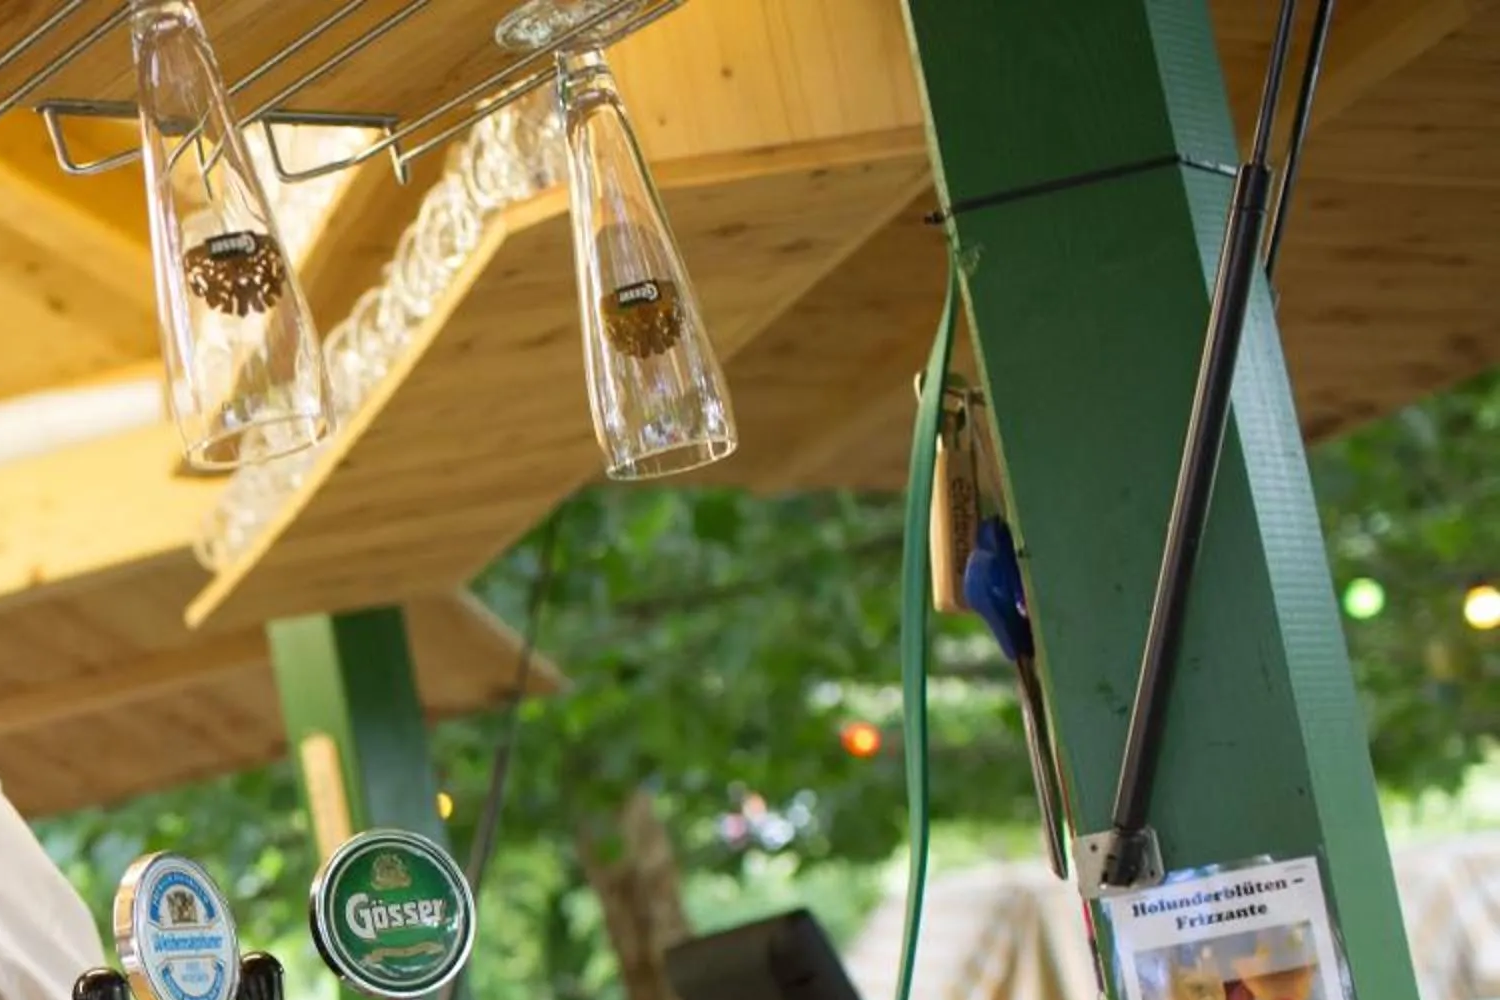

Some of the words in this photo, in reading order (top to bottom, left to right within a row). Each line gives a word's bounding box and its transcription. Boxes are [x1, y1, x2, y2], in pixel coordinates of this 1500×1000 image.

[345, 892, 446, 940] Gösser
[1132, 877, 1288, 917] Holunderblüten
[1175, 903, 1268, 930] Frizzante
